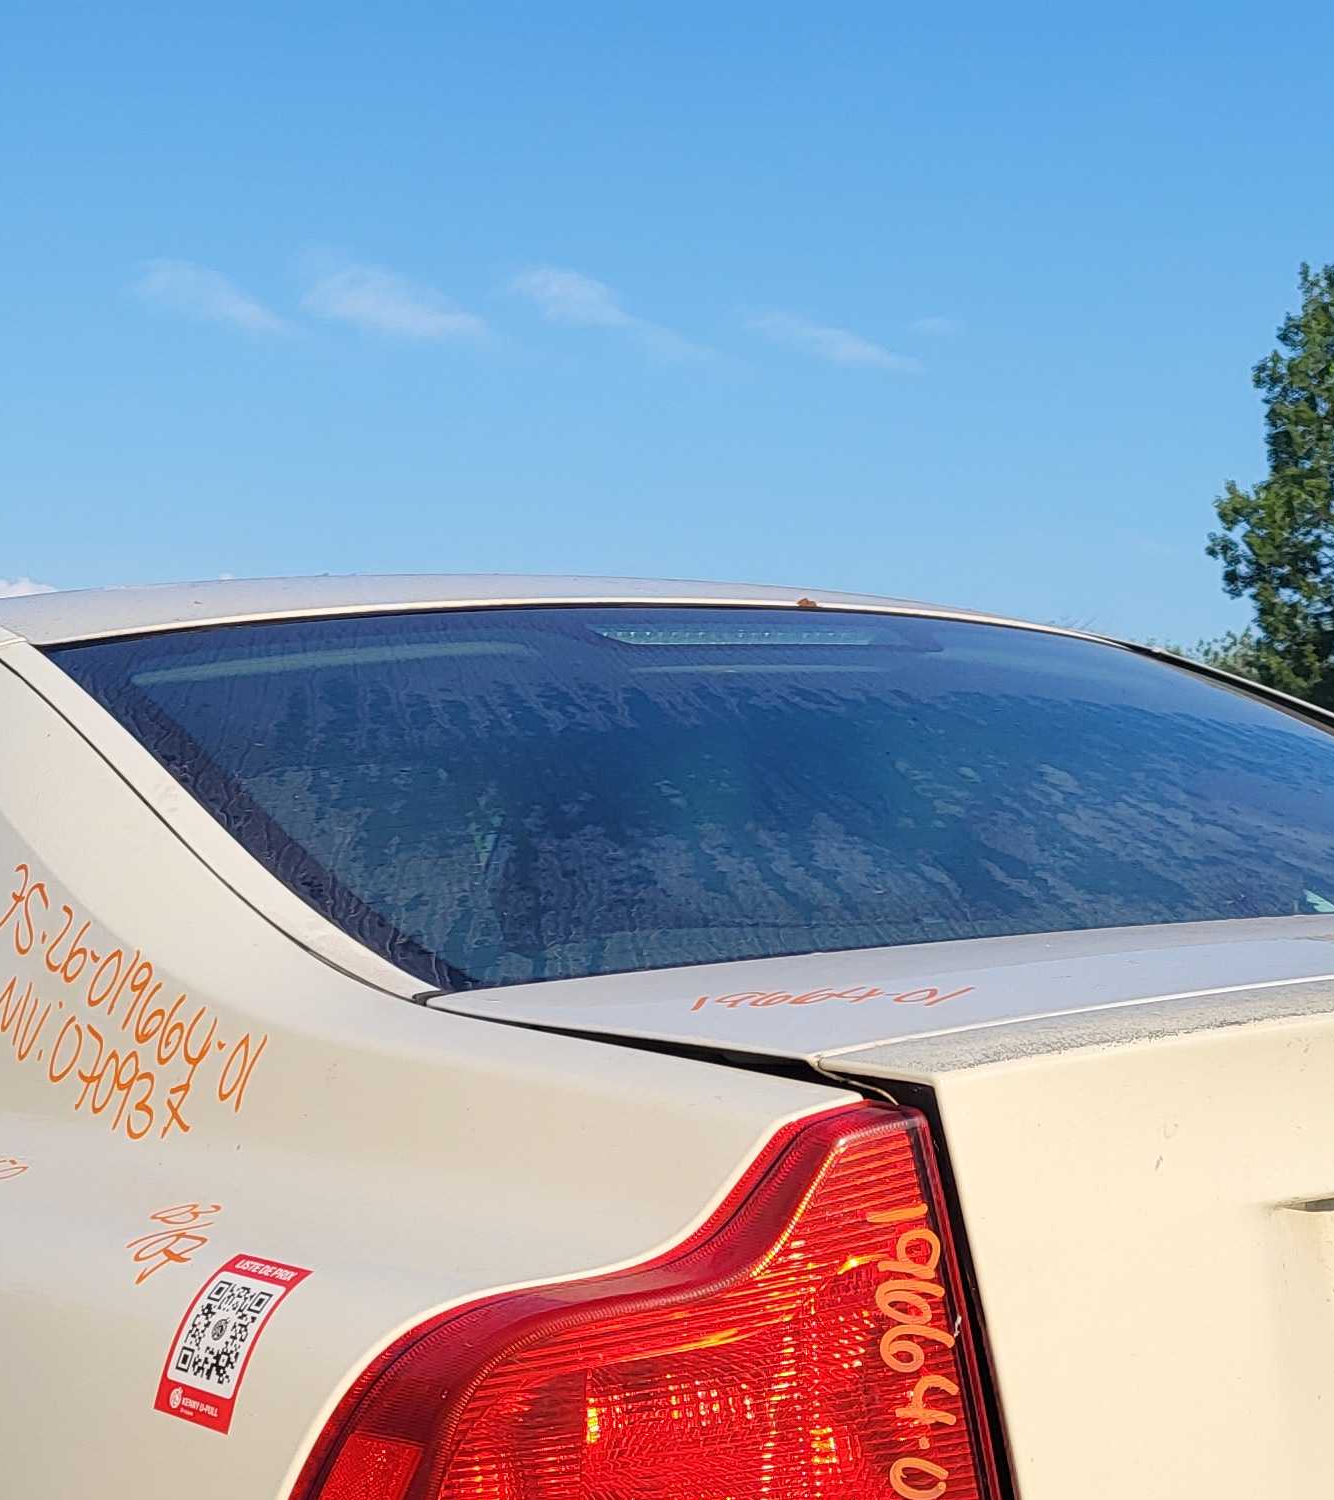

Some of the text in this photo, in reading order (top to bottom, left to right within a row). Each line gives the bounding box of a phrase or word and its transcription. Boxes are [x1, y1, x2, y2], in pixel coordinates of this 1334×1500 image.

[690, 986, 976, 1012] 19664-01
[234, 1259, 299, 1282] LISTE DE PRIX
